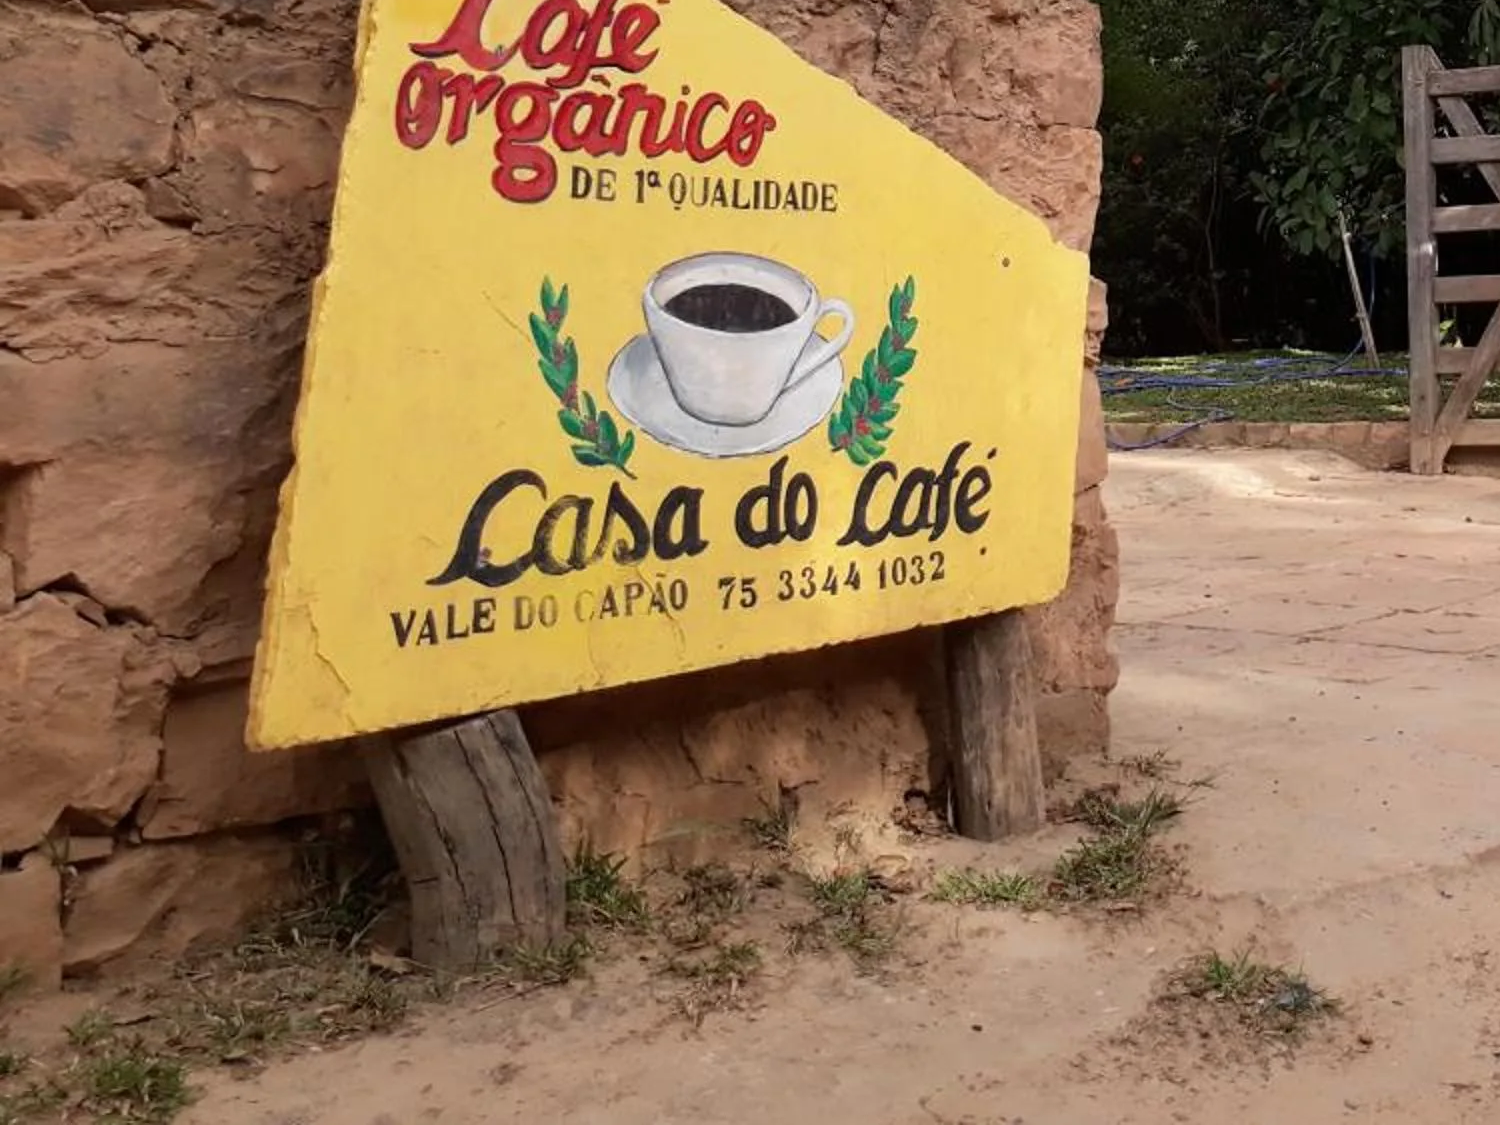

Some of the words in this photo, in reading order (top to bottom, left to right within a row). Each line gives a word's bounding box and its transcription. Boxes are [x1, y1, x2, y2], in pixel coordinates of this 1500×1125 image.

[571, 166, 617, 202] DE
[668, 172, 839, 212] QUALIDADE
[425, 468, 710, 586] Casa
[734, 455, 819, 549] do
[390, 597, 496, 647] VALE
[512, 593, 558, 631] DO
[573, 572, 689, 622] CAPÃO
[718, 575, 757, 611] 75
[777, 564, 862, 601] 3344
[876, 551, 946, 587] 1032
